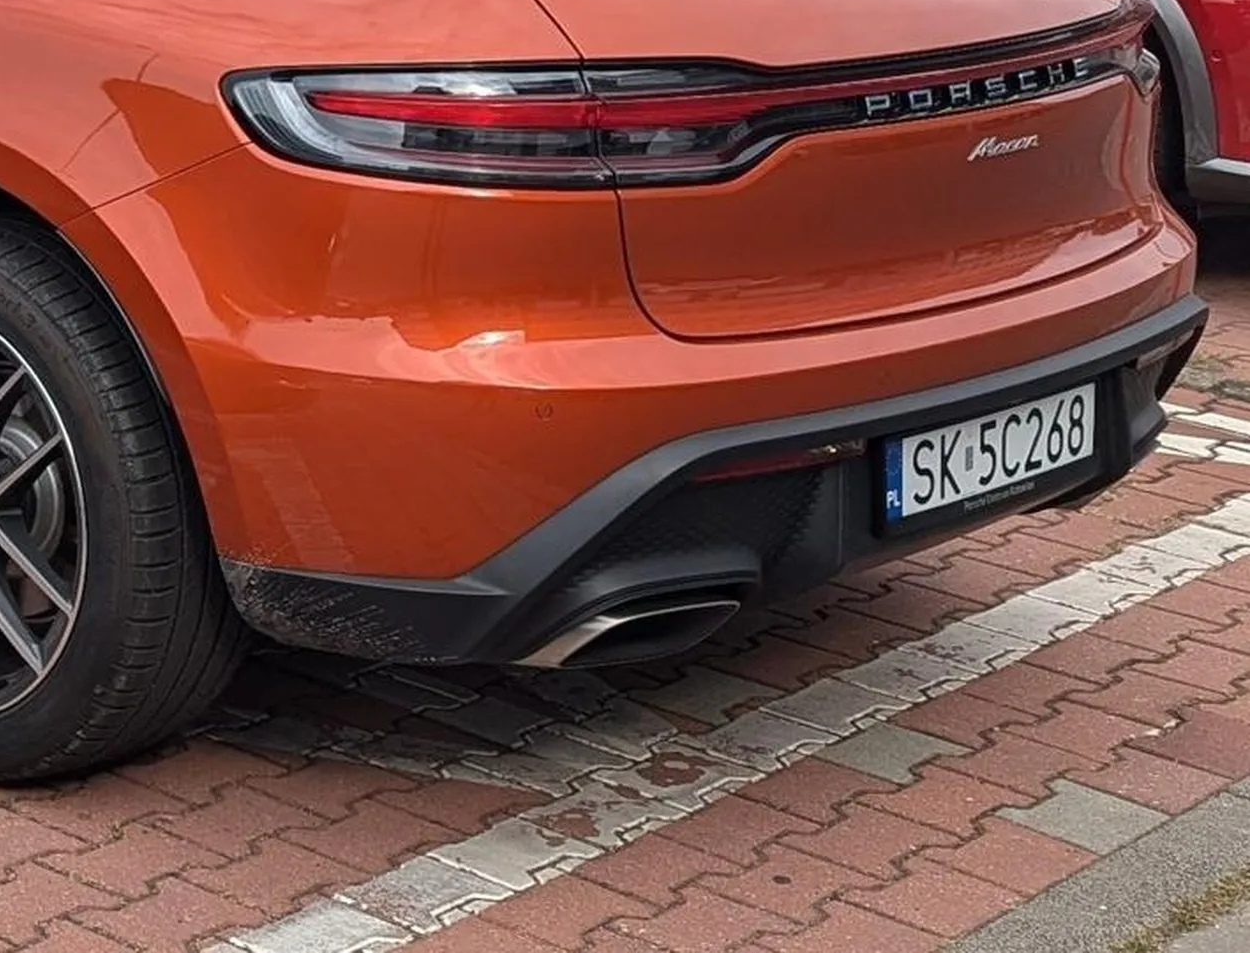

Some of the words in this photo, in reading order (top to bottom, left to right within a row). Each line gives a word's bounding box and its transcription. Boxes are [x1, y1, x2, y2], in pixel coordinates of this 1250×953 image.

[864, 57, 1092, 116] PORSCHE
[886, 491, 900, 510] PL
[912, 429, 962, 505] SK
[978, 394, 1086, 486] 5C268
